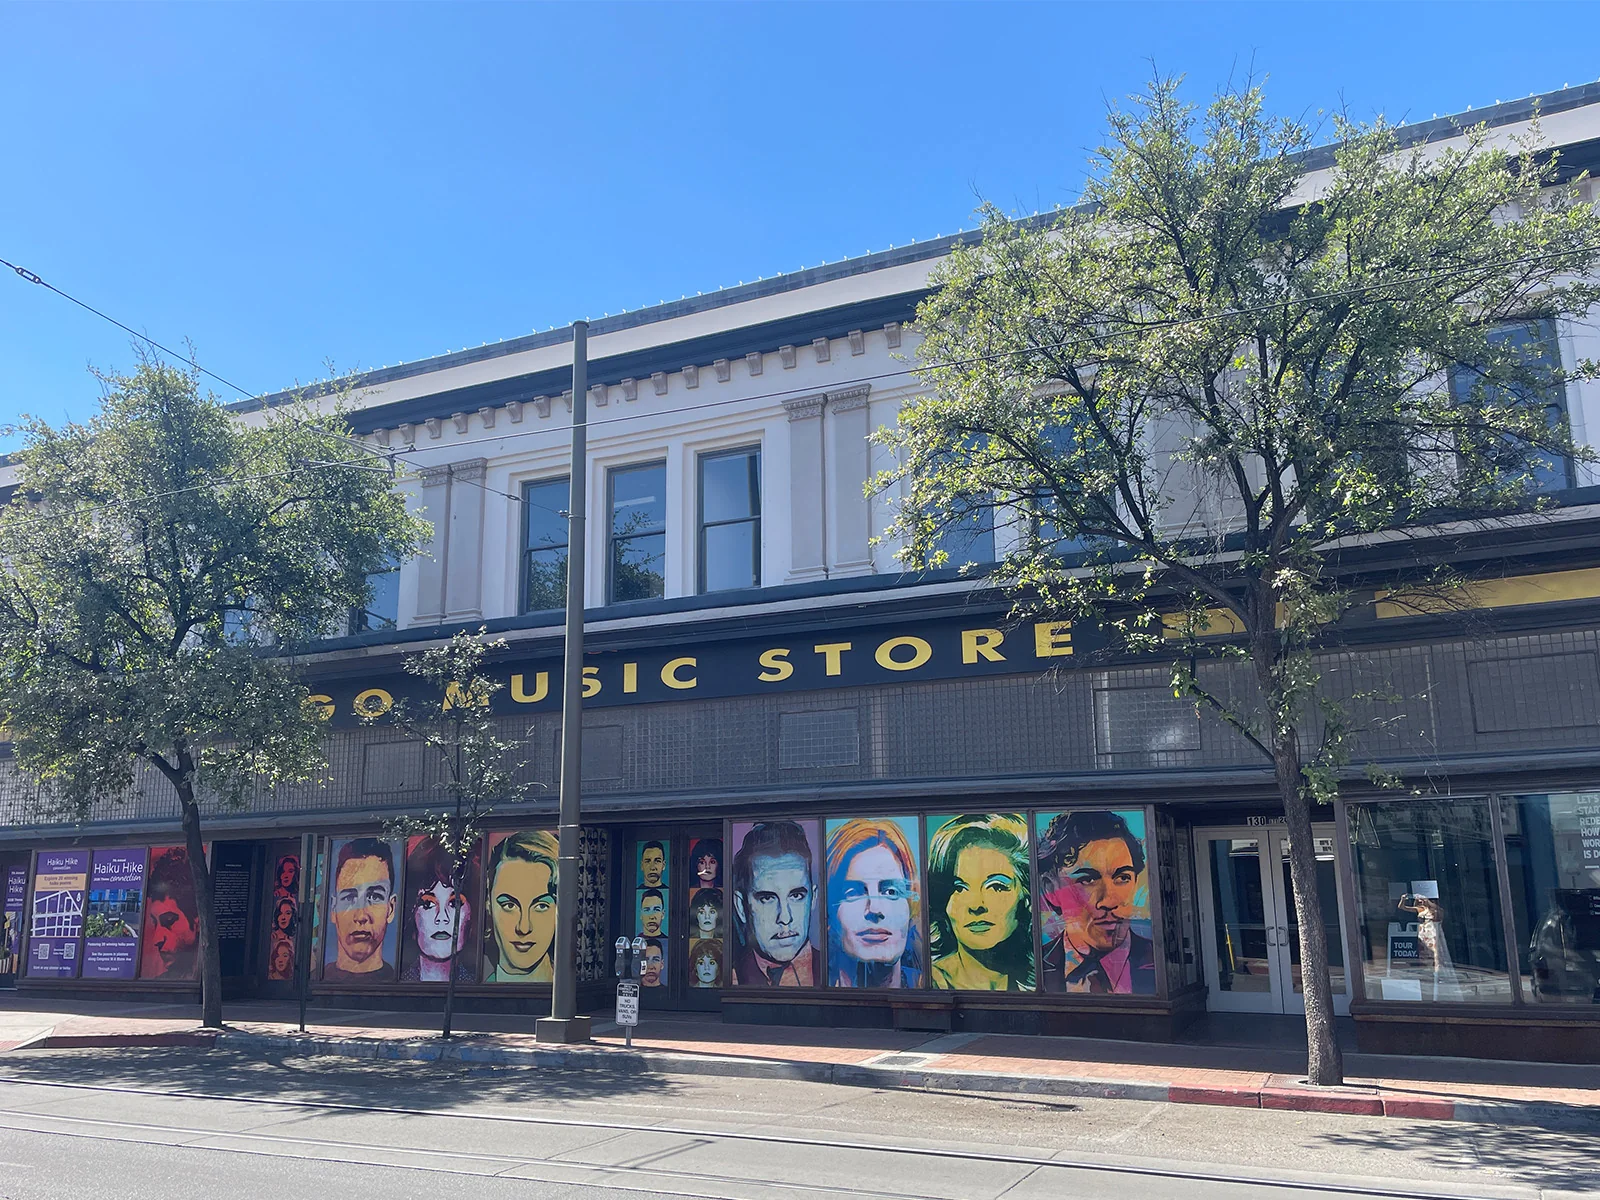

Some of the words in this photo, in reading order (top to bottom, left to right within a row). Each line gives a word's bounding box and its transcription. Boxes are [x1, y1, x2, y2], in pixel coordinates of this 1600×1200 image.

[442, 656, 698, 711] MUSIC
[757, 620, 1074, 683] STORE
[1577, 795, 1599, 804] LET'S
[1248, 816, 1266, 826] 130
[1581, 828, 1600, 837] HOW
[1584, 850, 1592, 859] IS
[65, 857, 78, 865] Hike
[94, 863, 120, 874] Haiku
[122, 862, 143, 873] Hike
[110, 873, 141, 882] connection
